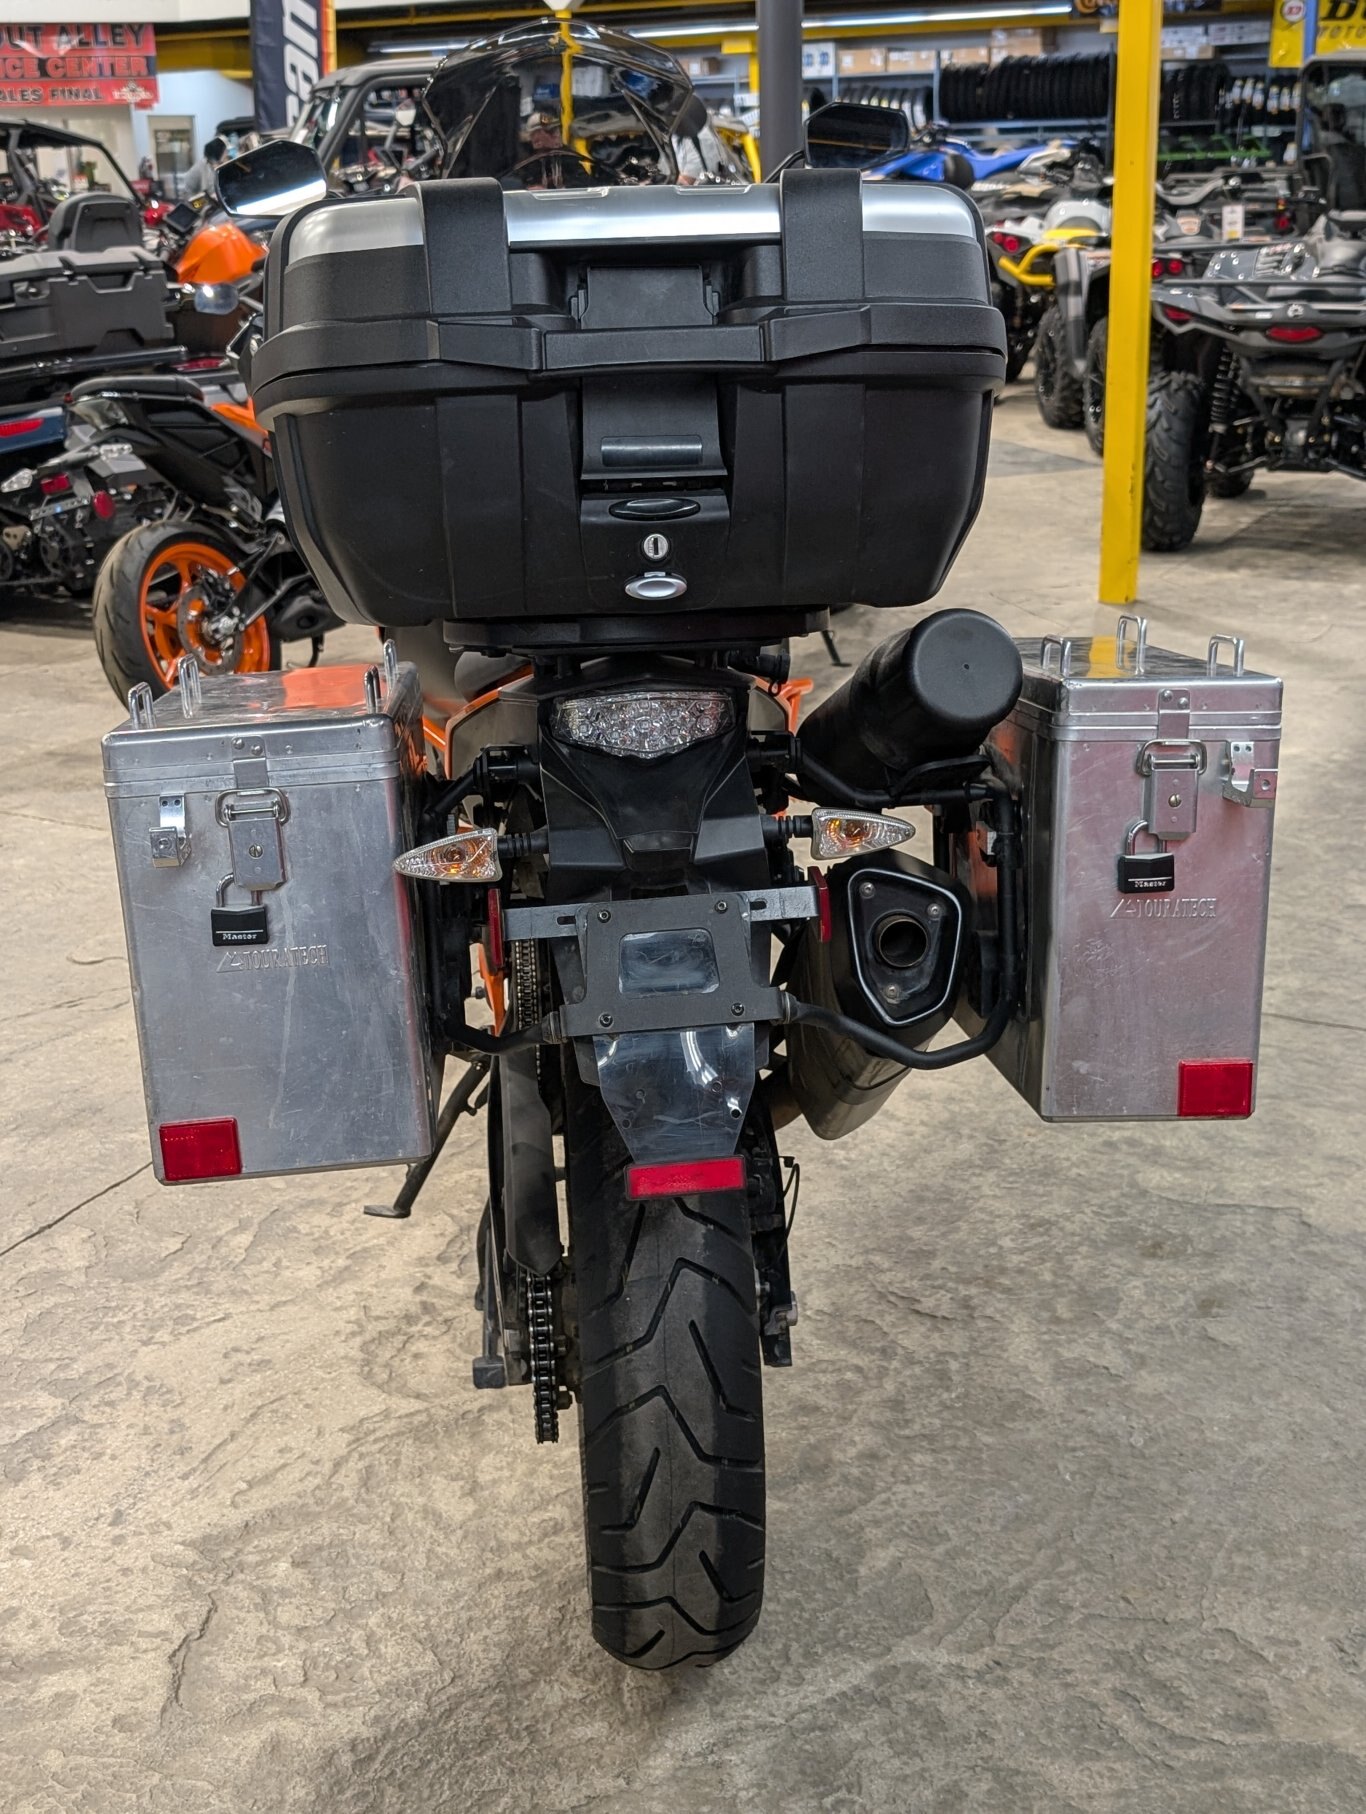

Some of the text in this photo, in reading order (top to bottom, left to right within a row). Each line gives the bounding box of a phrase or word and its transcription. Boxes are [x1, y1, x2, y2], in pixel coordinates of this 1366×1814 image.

[0, 23, 145, 50] UT ALLEY
[45, 57, 148, 78] CENTER
[50, 86, 102, 102] FINAL
[1137, 898, 1217, 919] TOURATECH
[243, 945, 329, 970] TOURATECH
